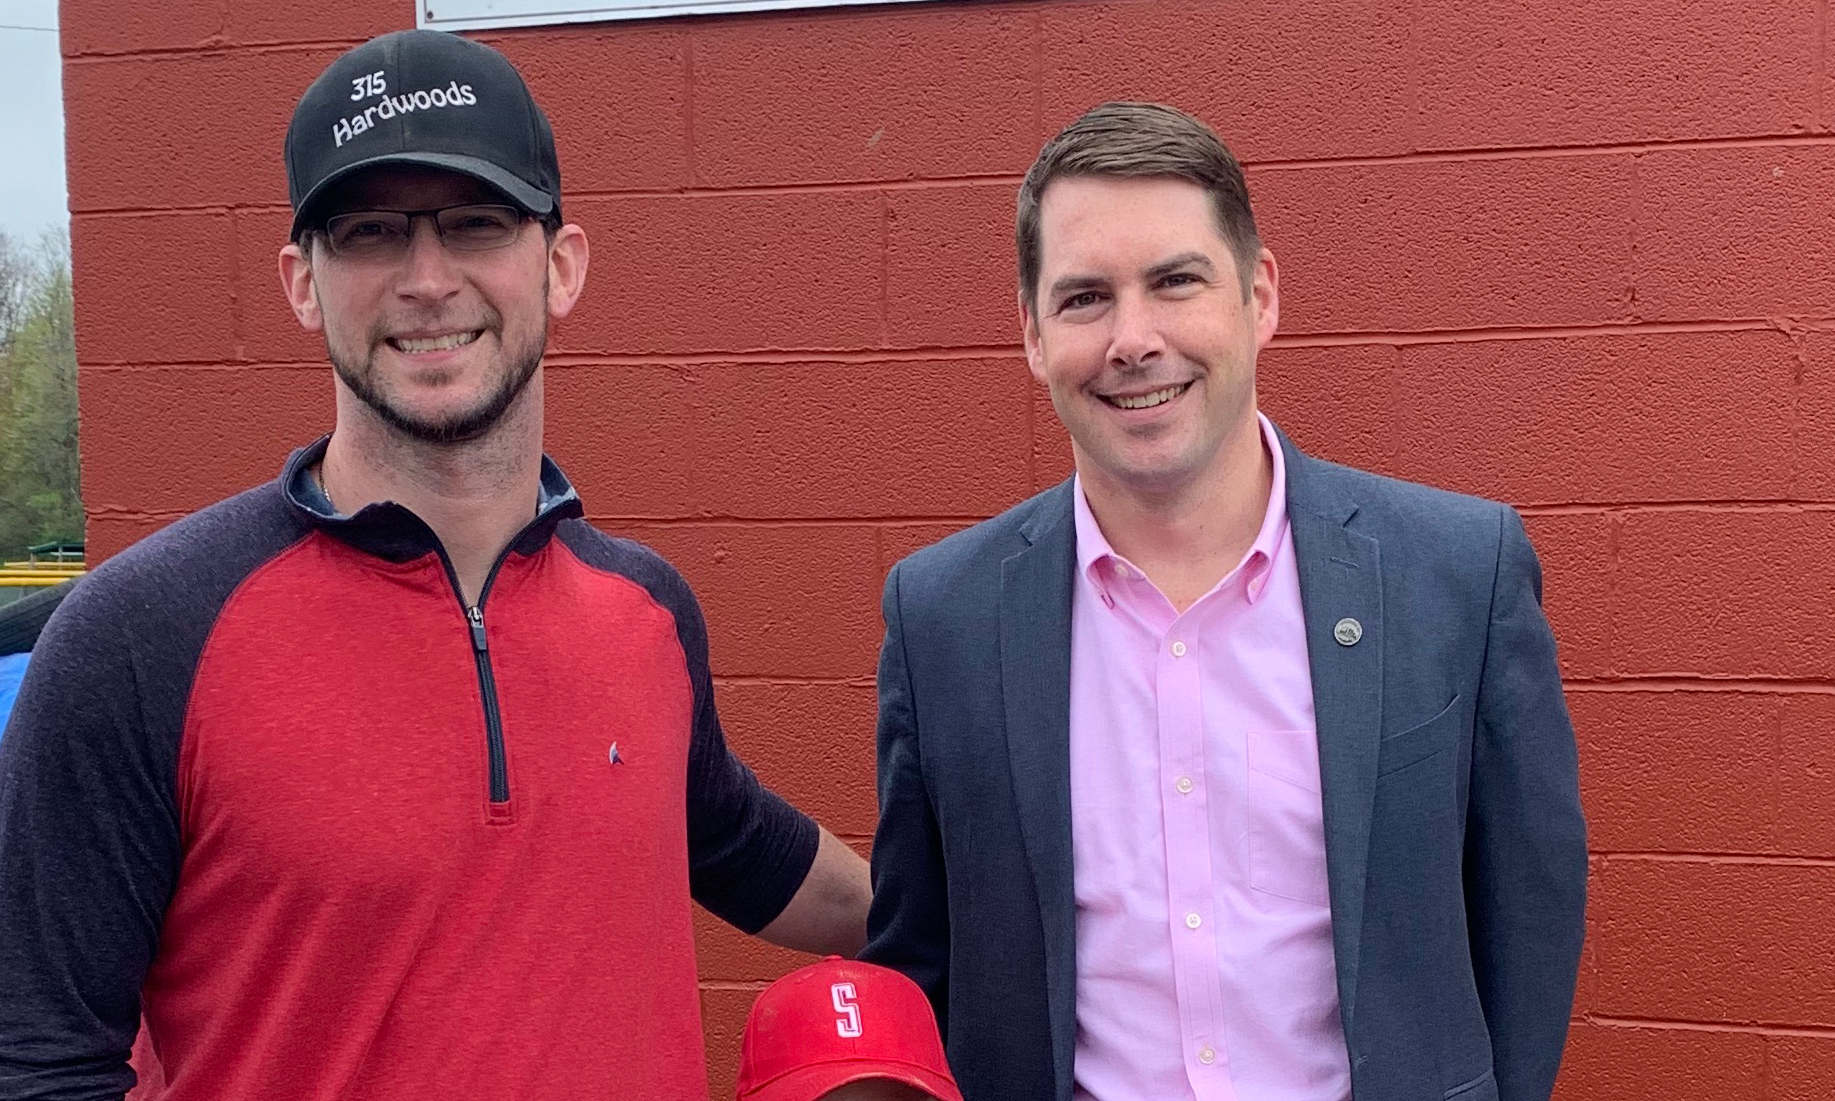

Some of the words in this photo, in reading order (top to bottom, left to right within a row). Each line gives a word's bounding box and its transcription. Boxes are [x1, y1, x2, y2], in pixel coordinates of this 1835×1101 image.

[332, 80, 477, 148] Hardwoods
[350, 70, 387, 102] 315
[830, 982, 863, 1038] S
